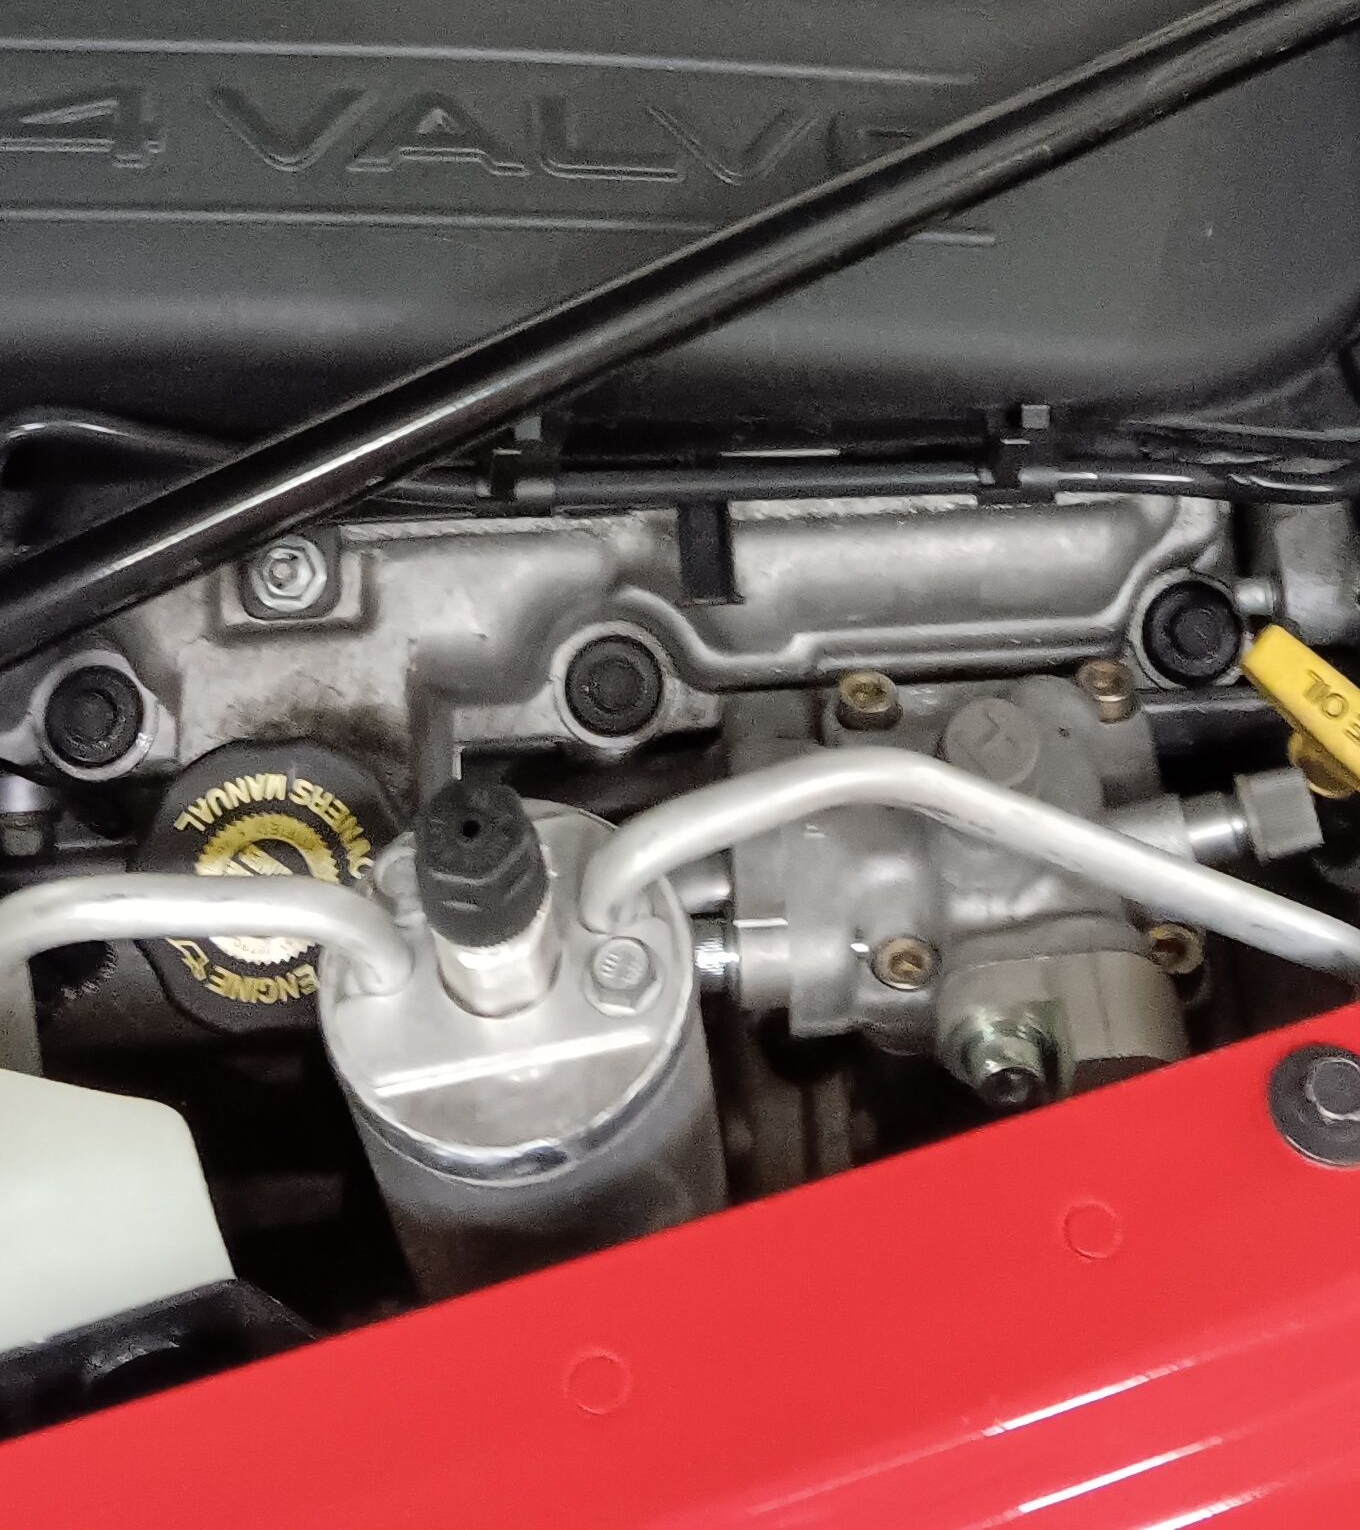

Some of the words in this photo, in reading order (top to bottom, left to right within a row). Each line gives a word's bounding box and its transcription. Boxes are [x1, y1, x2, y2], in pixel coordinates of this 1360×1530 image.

[1300, 668, 1350, 720] OIL
[173, 772, 288, 832] MANUAL
[206, 962, 319, 1005] ENGINE
